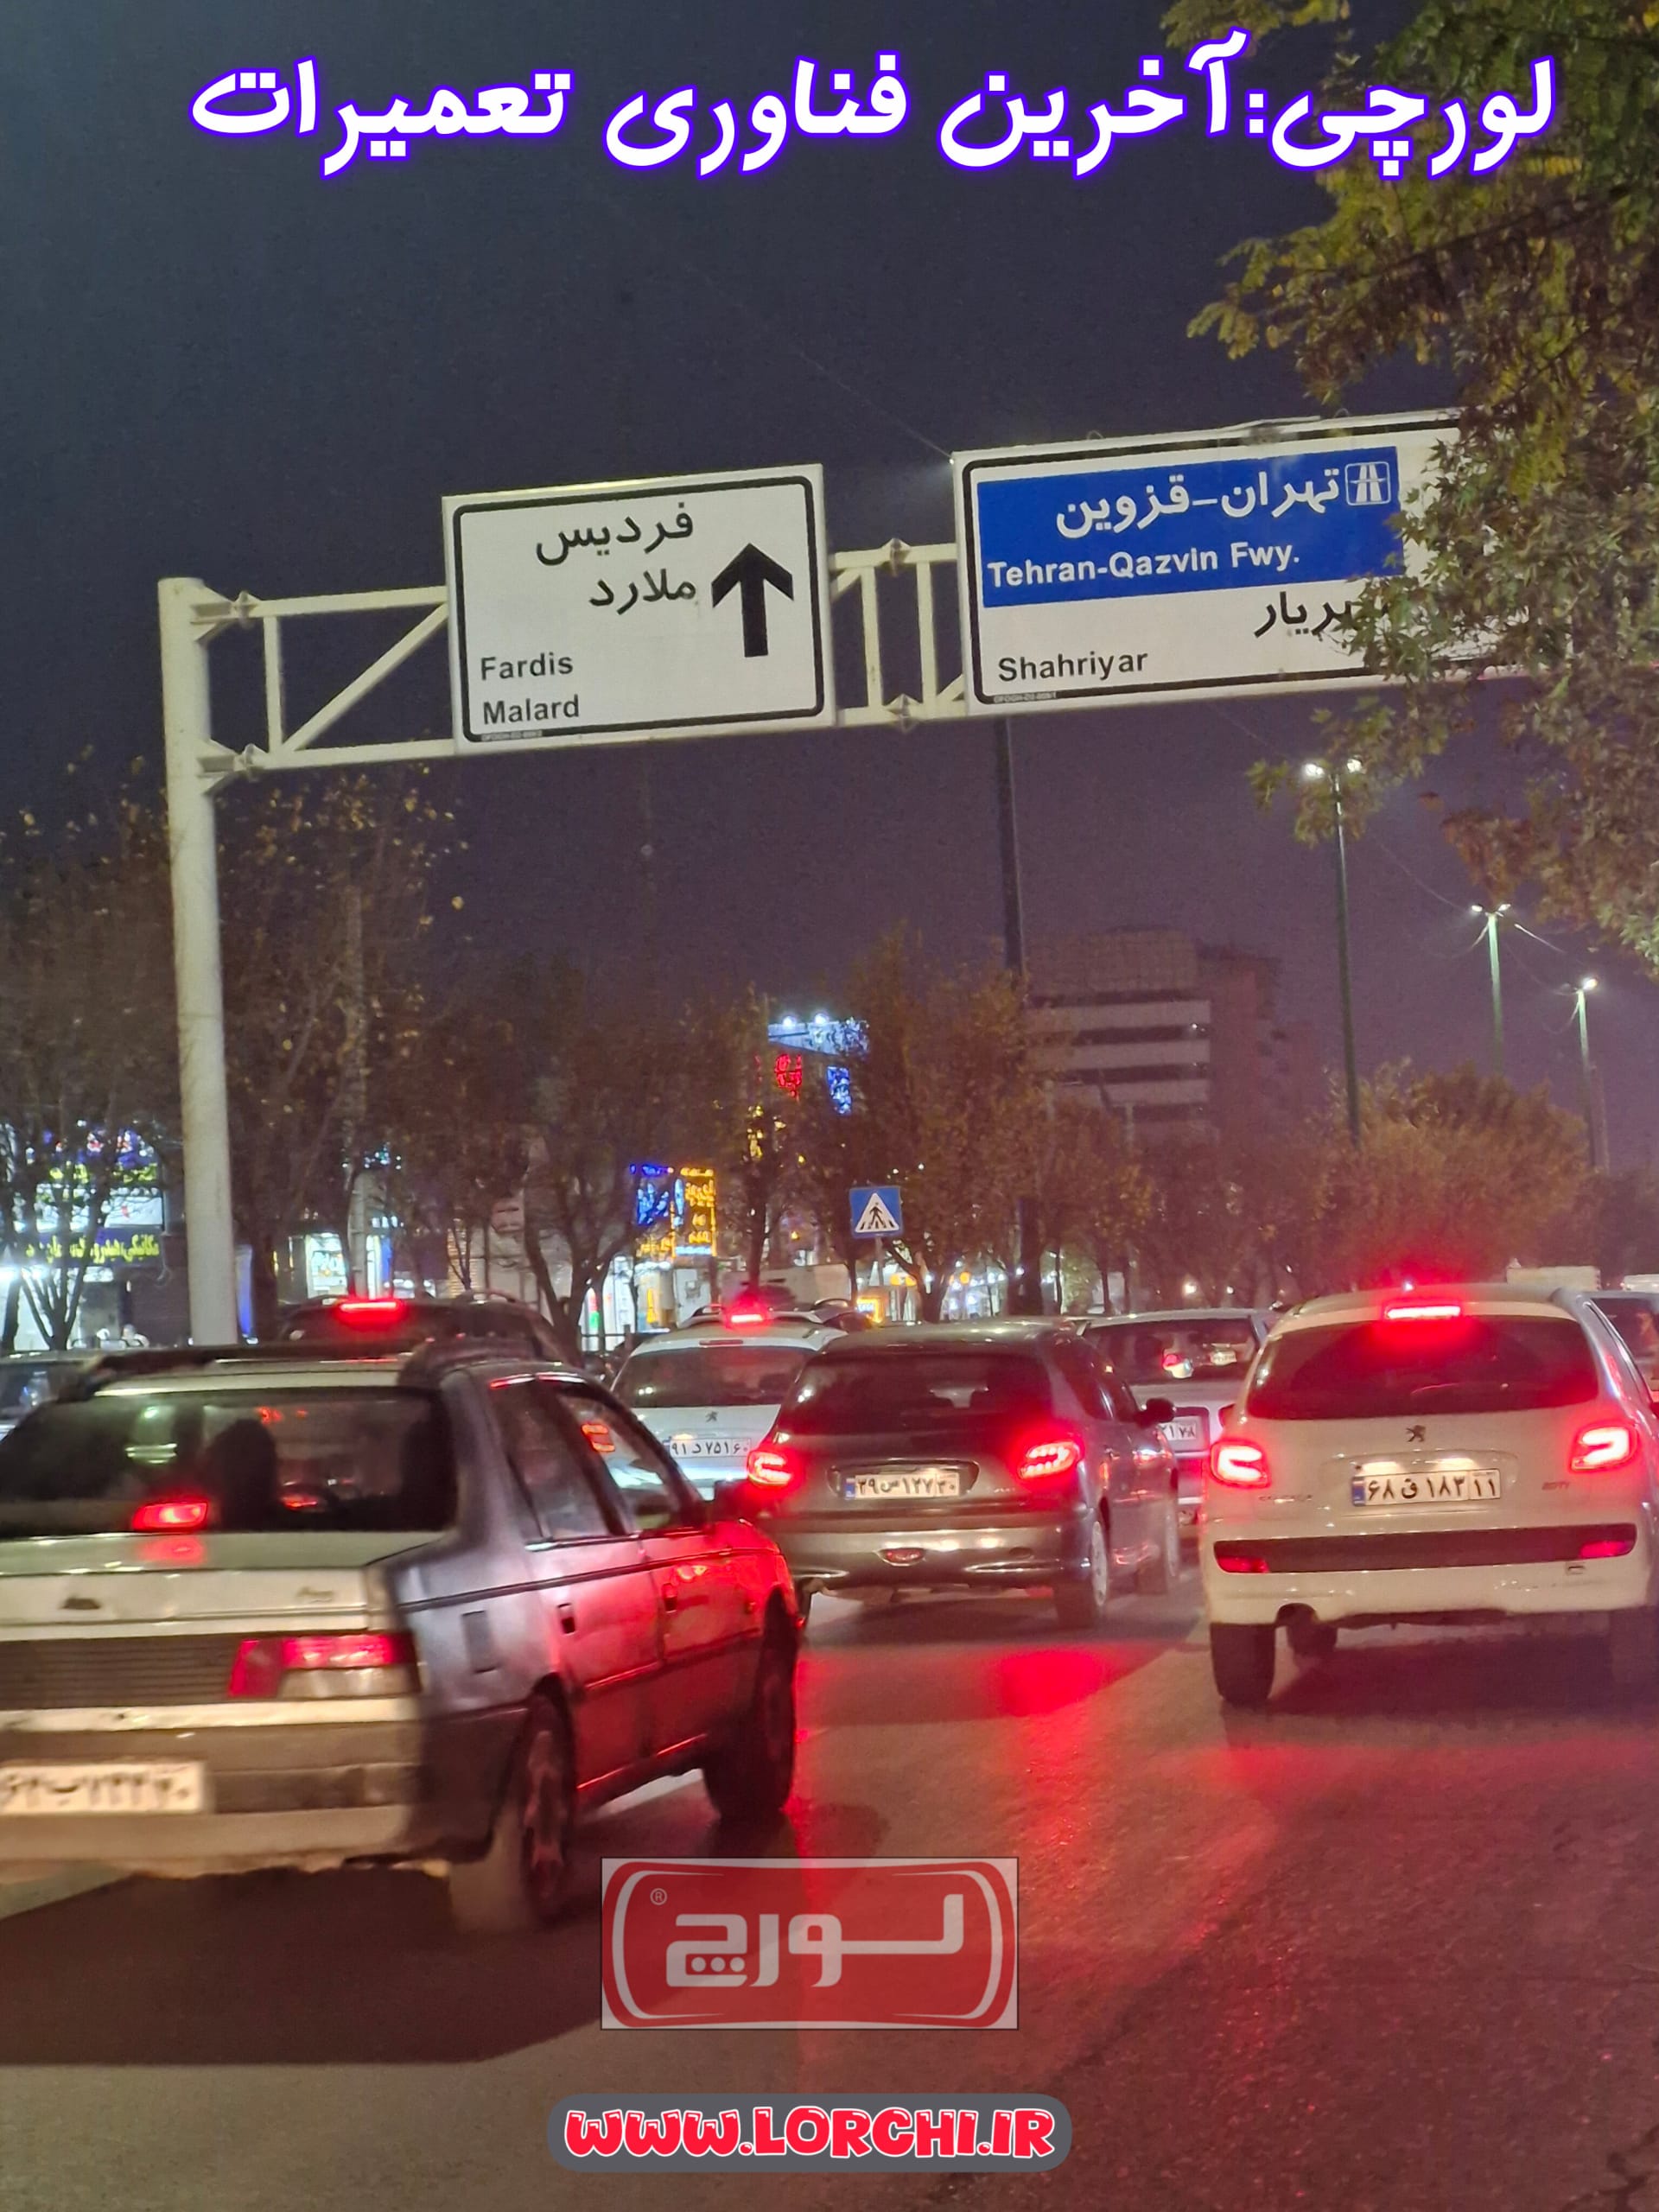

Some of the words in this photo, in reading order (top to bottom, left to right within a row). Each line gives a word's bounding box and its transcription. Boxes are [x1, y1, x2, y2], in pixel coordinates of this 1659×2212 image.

[536, 501, 694, 566] فردیس
[988, 546, 1218, 588] Tehran-Qazvin
[1230, 540, 1300, 574] Fwy.
[589, 569, 696, 615] ملارد
[480, 652, 574, 681] Fardis
[998, 650, 1148, 682] Shahriyar
[483, 694, 581, 725] Malard
